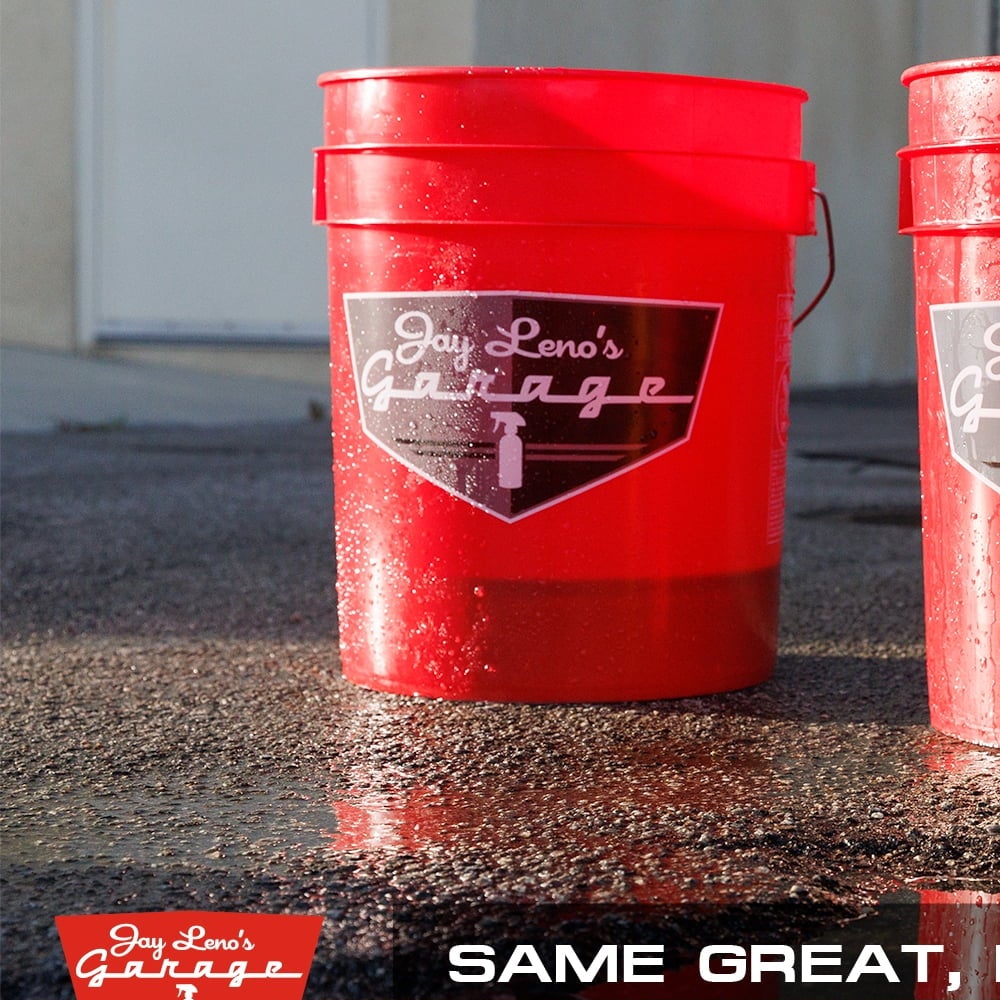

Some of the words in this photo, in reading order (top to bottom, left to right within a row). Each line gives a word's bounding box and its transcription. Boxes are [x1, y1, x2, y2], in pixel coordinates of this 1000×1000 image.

[394, 310, 473, 371] Jay
[485, 316, 624, 360] Leno's
[361, 349, 695, 419] Garage
